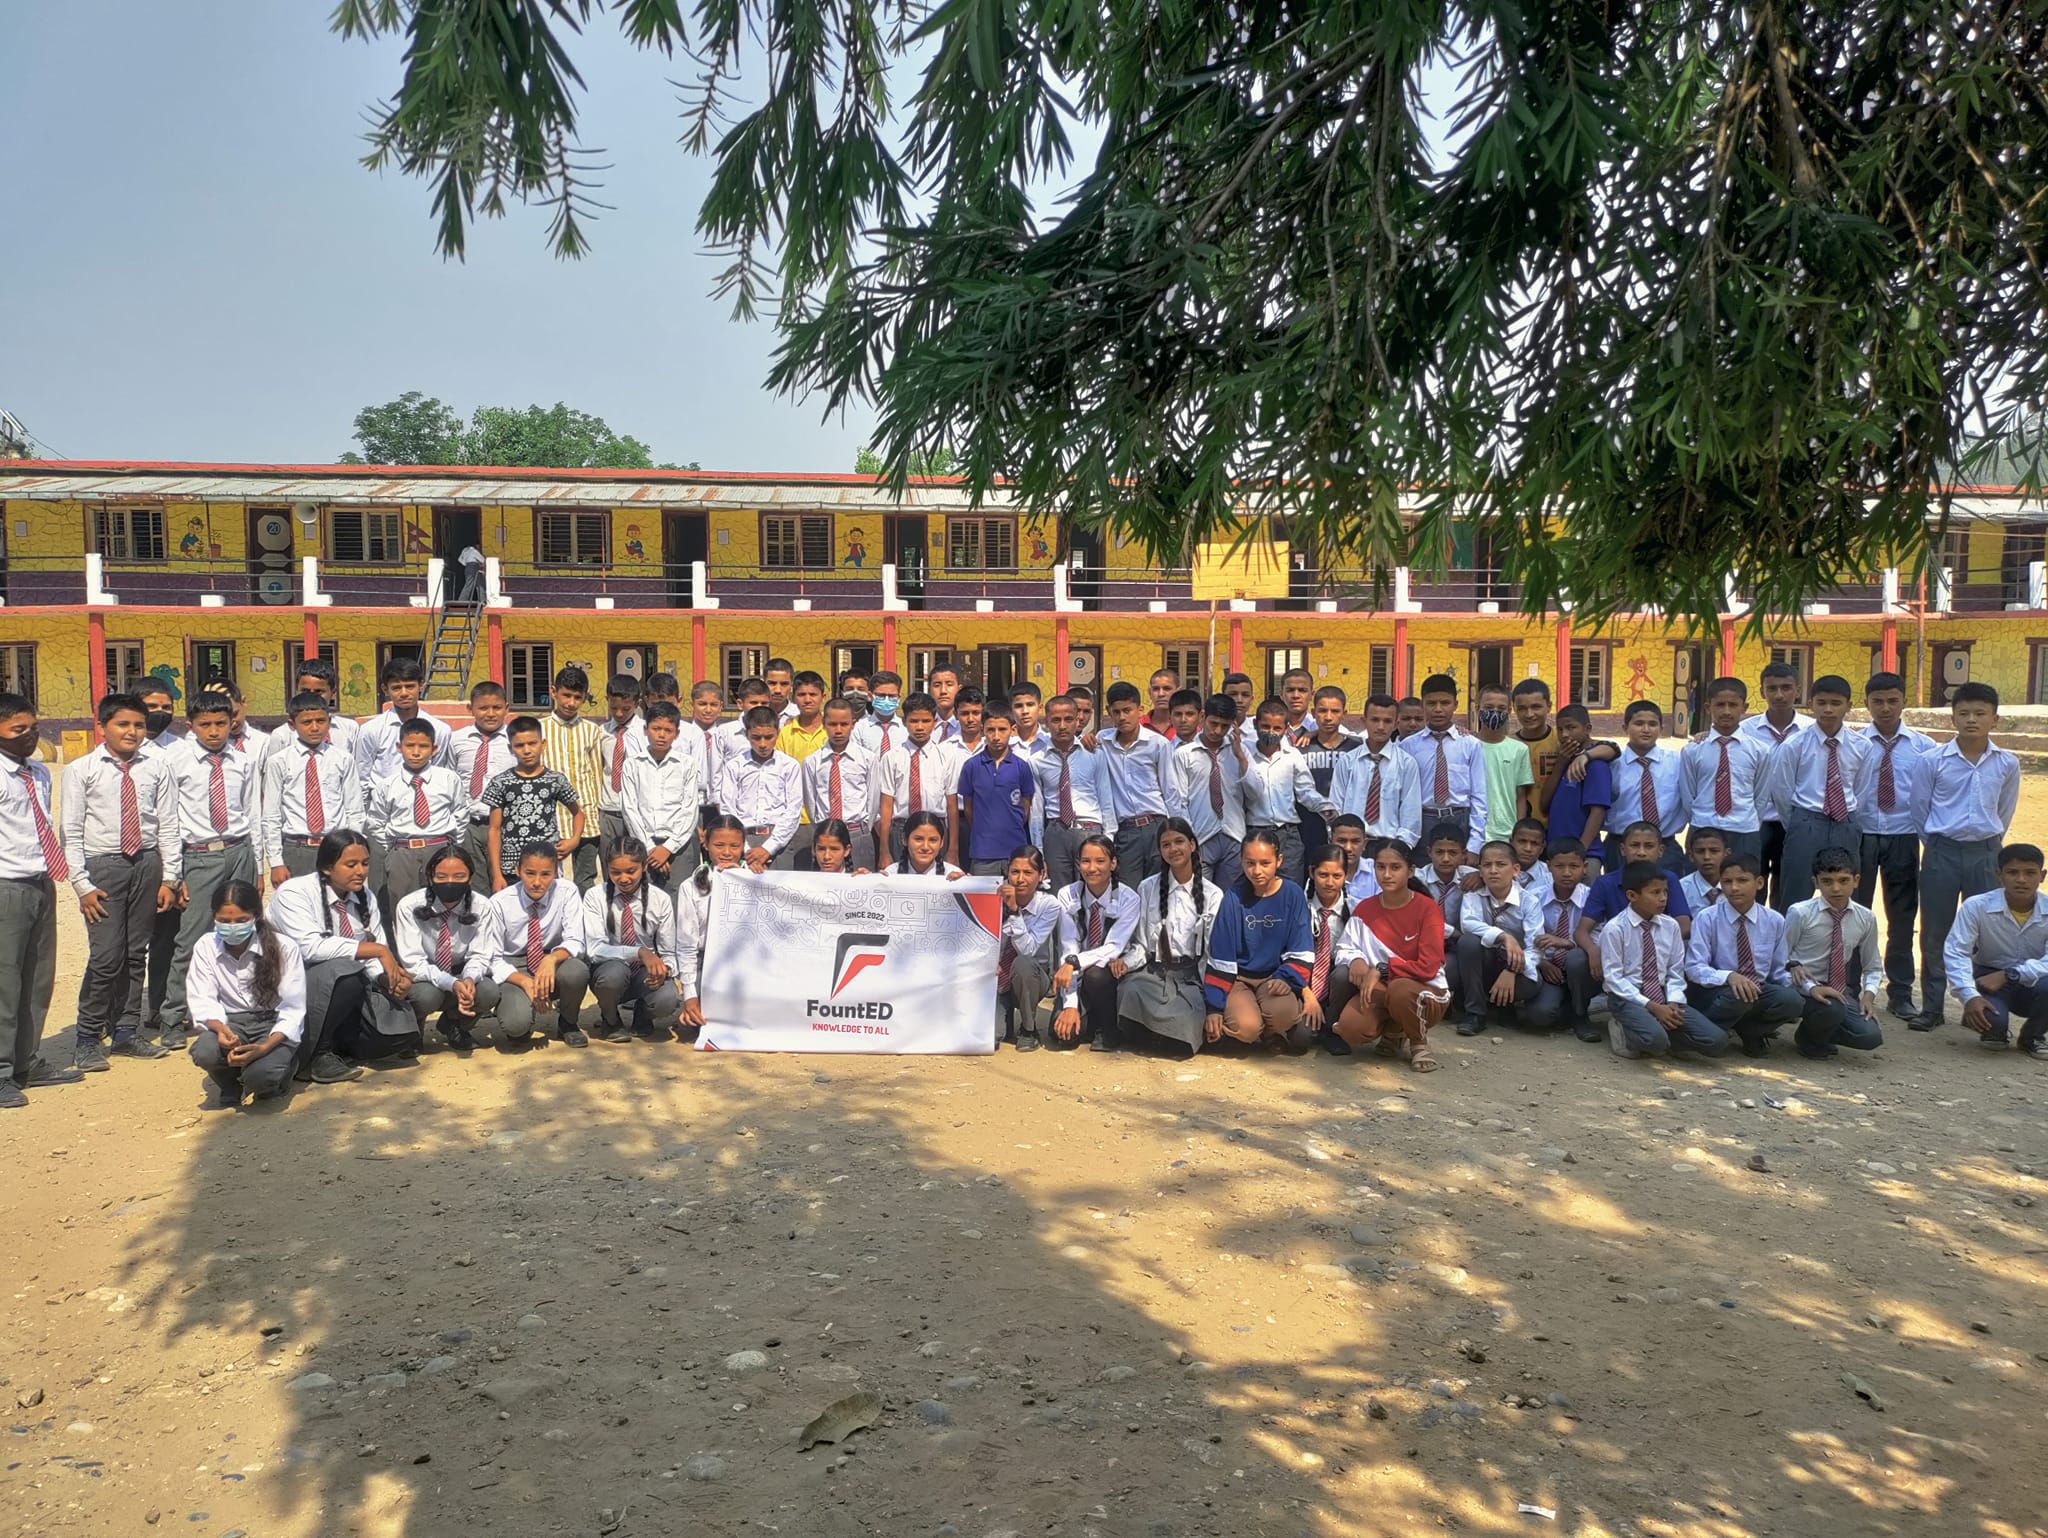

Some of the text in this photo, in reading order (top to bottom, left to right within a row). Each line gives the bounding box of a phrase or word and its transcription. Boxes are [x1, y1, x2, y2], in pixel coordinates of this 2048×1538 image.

[269, 523, 280, 534] 20
[845, 911, 885, 921] SINCE 2022
[807, 999, 894, 1020] FountED
[812, 1023, 890, 1036] KNOWLEDGE TO ALL
